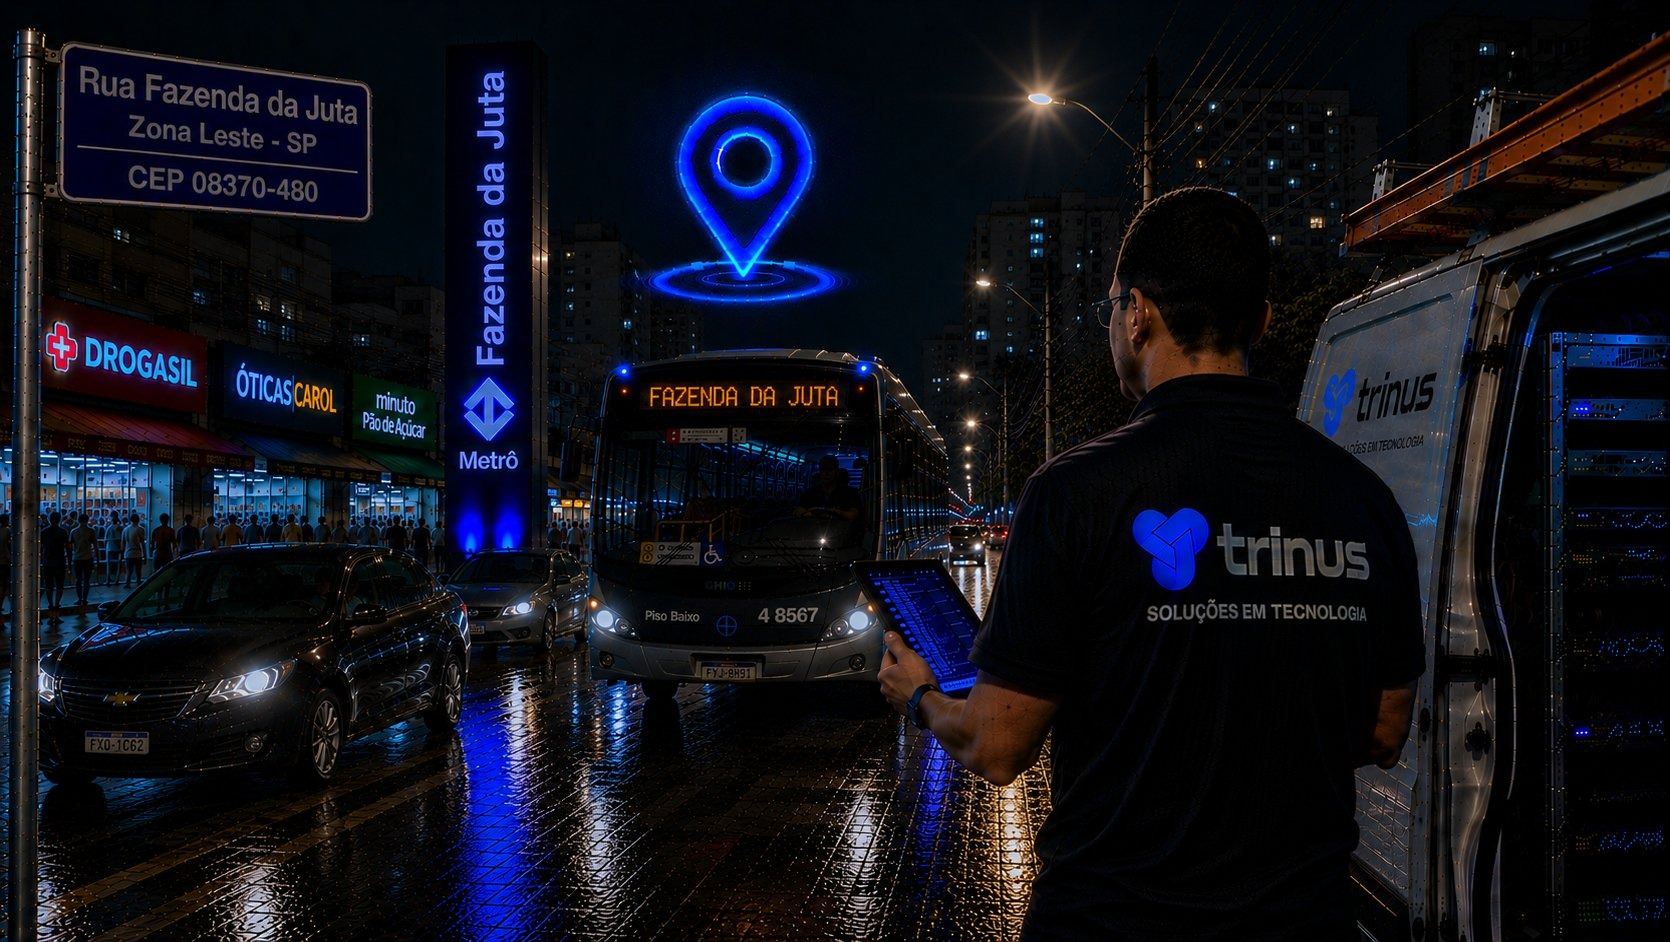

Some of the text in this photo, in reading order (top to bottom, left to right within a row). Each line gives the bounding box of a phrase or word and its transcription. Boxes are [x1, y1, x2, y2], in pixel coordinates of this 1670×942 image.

[79, 65, 358, 125] Rua Fazenda da Juta
[128, 114, 192, 143] Zona
[199, 122, 265, 150] Leste
[286, 131, 318, 155] SP
[128, 164, 319, 203] CEP 08370-480
[476, 70, 505, 366] Fazenda da Juta
[85, 336, 198, 388] DROGASIL
[236, 362, 337, 414] ÓTICAS CAROL
[376, 391, 416, 415] minuto
[650, 386, 839, 407] FAZENDA DA JUTA
[1357, 372, 1437, 422] trinus
[362, 411, 426, 440] Pão de Açúcar
[459, 450, 519, 470] Metrô
[1368, 441, 1378, 453] EM
[1217, 523, 1370, 580] trinus
[645, 609, 700, 623] Piso Baixo
[758, 607, 819, 623] 4 8567
[1146, 598, 1367, 624] SOLUÇÕES EM TECNOLOGIA
